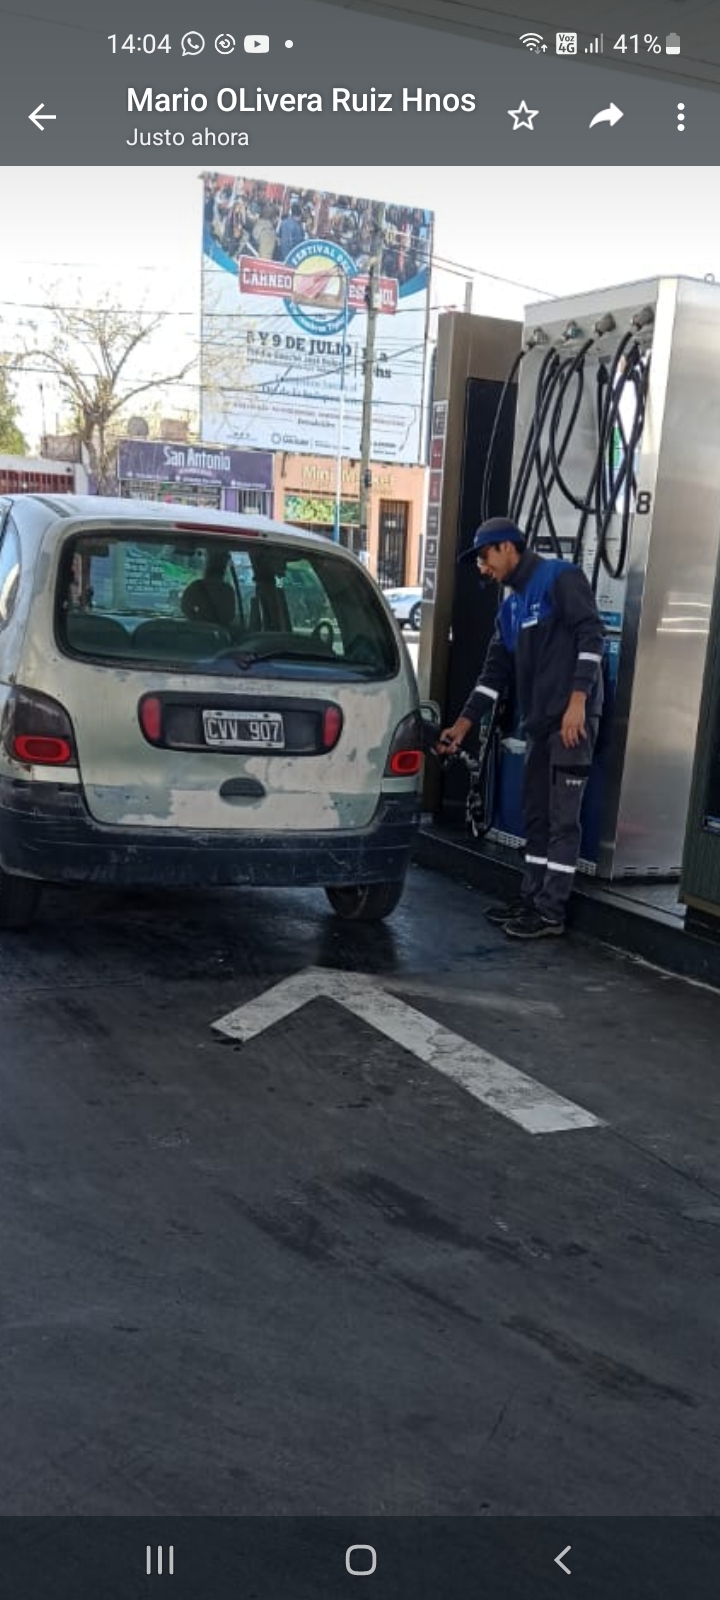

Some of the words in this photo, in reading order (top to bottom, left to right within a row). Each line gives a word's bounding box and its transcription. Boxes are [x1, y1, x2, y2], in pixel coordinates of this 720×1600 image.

[258, 331, 269, 346] Y
[272, 334, 281, 348] 9
[285, 336, 307, 352] DE
[308, 339, 352, 357] JULIO
[163, 446, 184, 466] San
[187, 448, 231, 471] Antonio
[302, 465, 333, 483] Mini
[635, 491, 651, 515] 8
[207, 718, 238, 740] CVV
[250, 721, 280, 742] 907
